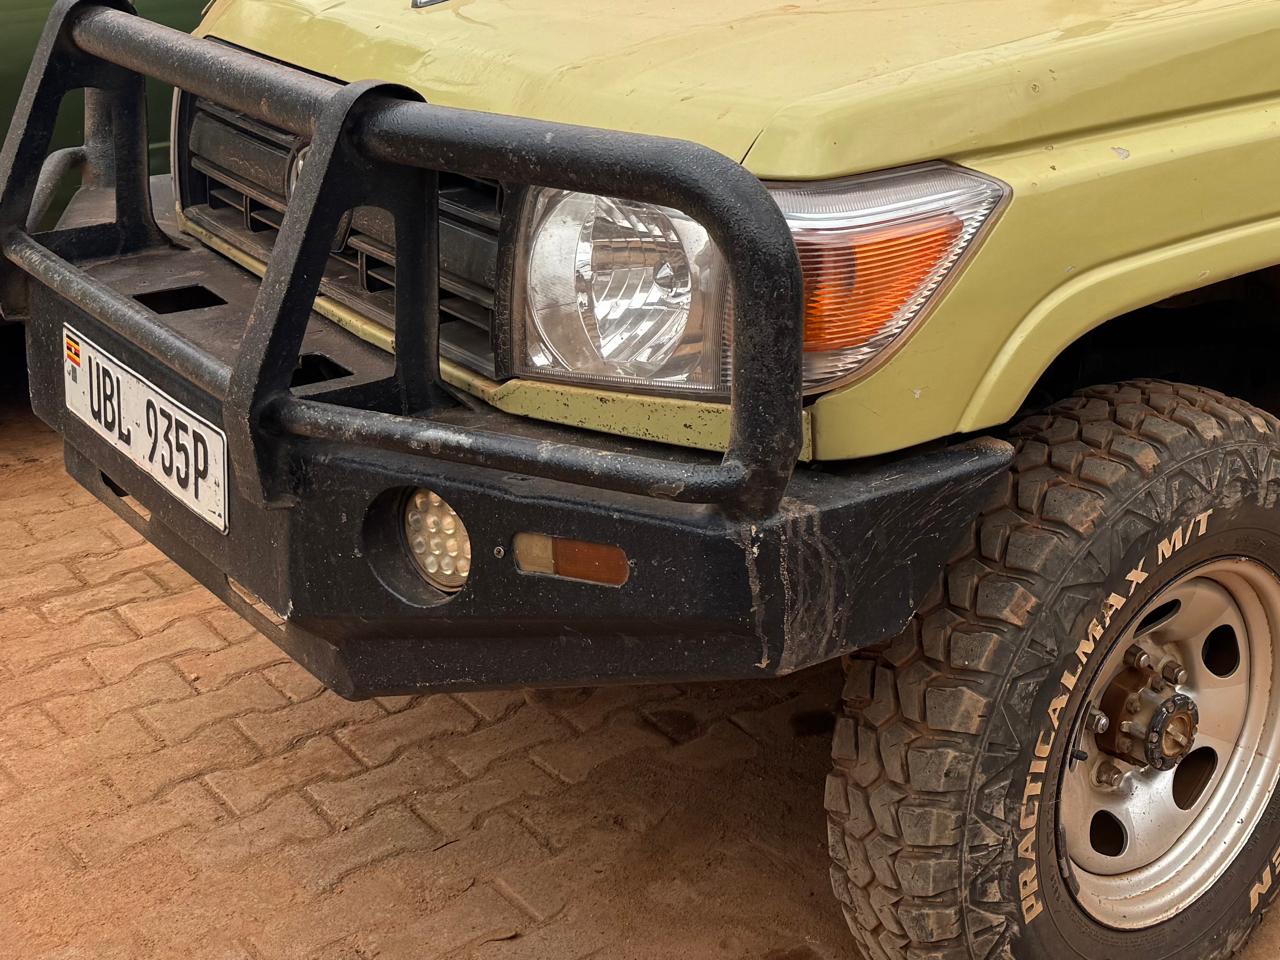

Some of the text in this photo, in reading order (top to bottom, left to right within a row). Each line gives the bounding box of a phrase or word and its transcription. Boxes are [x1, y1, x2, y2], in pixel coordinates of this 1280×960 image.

[88, 355, 209, 500] UBL 935P
[1156, 509, 1214, 565] M/T
